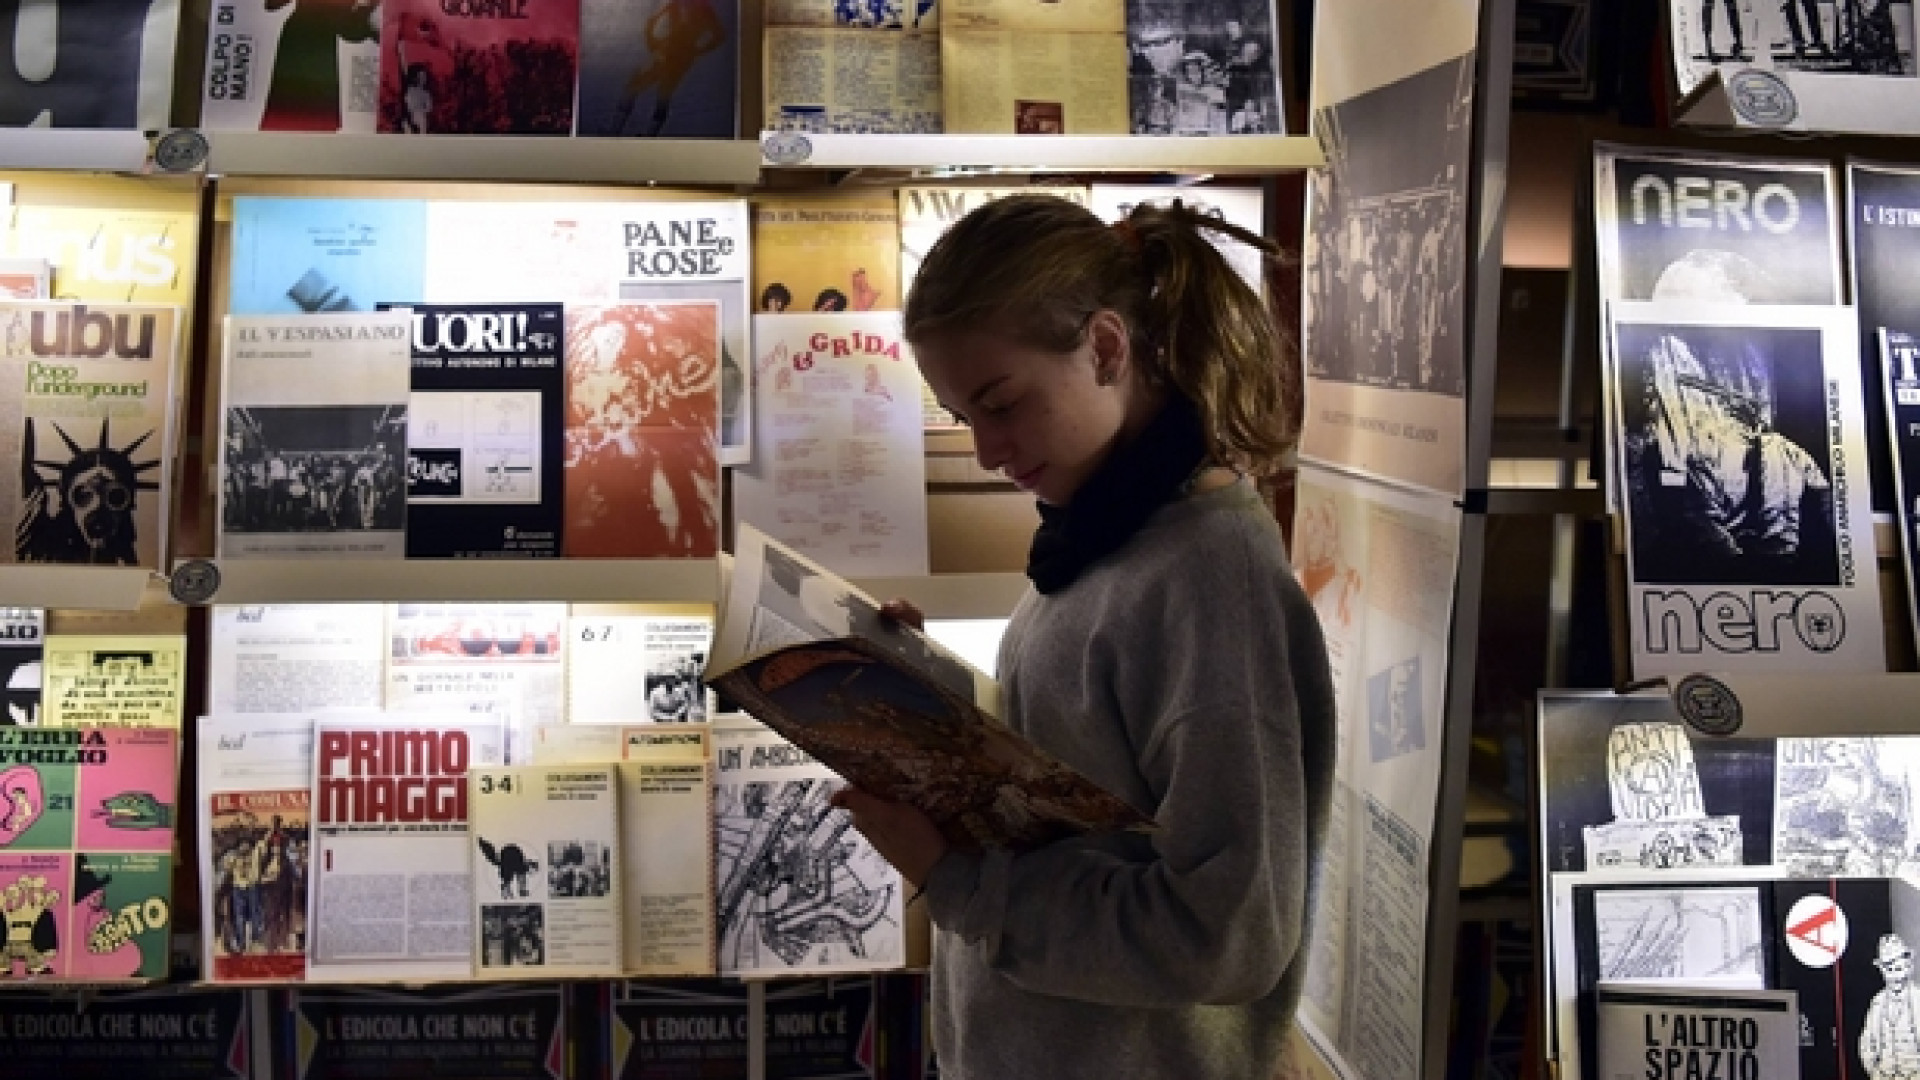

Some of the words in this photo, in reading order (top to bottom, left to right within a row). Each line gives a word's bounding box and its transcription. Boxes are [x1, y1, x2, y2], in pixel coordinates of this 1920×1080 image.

[218, 5, 235, 25] DI
[1631, 173, 1800, 234] NERO
[622, 217, 718, 247] PANE
[627, 248, 723, 277] ROSE
[31, 304, 156, 359] ubu
[411, 312, 529, 353] UORI!
[810, 331, 901, 362] GRIDA
[1833, 447, 1850, 531] ANARCHICO
[1839, 535, 1855, 588] FOGLIO
[1643, 589, 1846, 654] nero
[320, 731, 469, 776] PRIMO
[48, 795, 73, 810] 21
[319, 778, 468, 823] MAGGI
[99, 1013, 135, 1038] CHE
[140, 1013, 182, 1038] NON
[422, 1014, 458, 1039] CHE
[463, 1014, 505, 1039] NON
[775, 1013, 816, 1037] NON
[1644, 1013, 1760, 1052] L'ALTRO
[1644, 1050, 1760, 1080] SPAZIO
